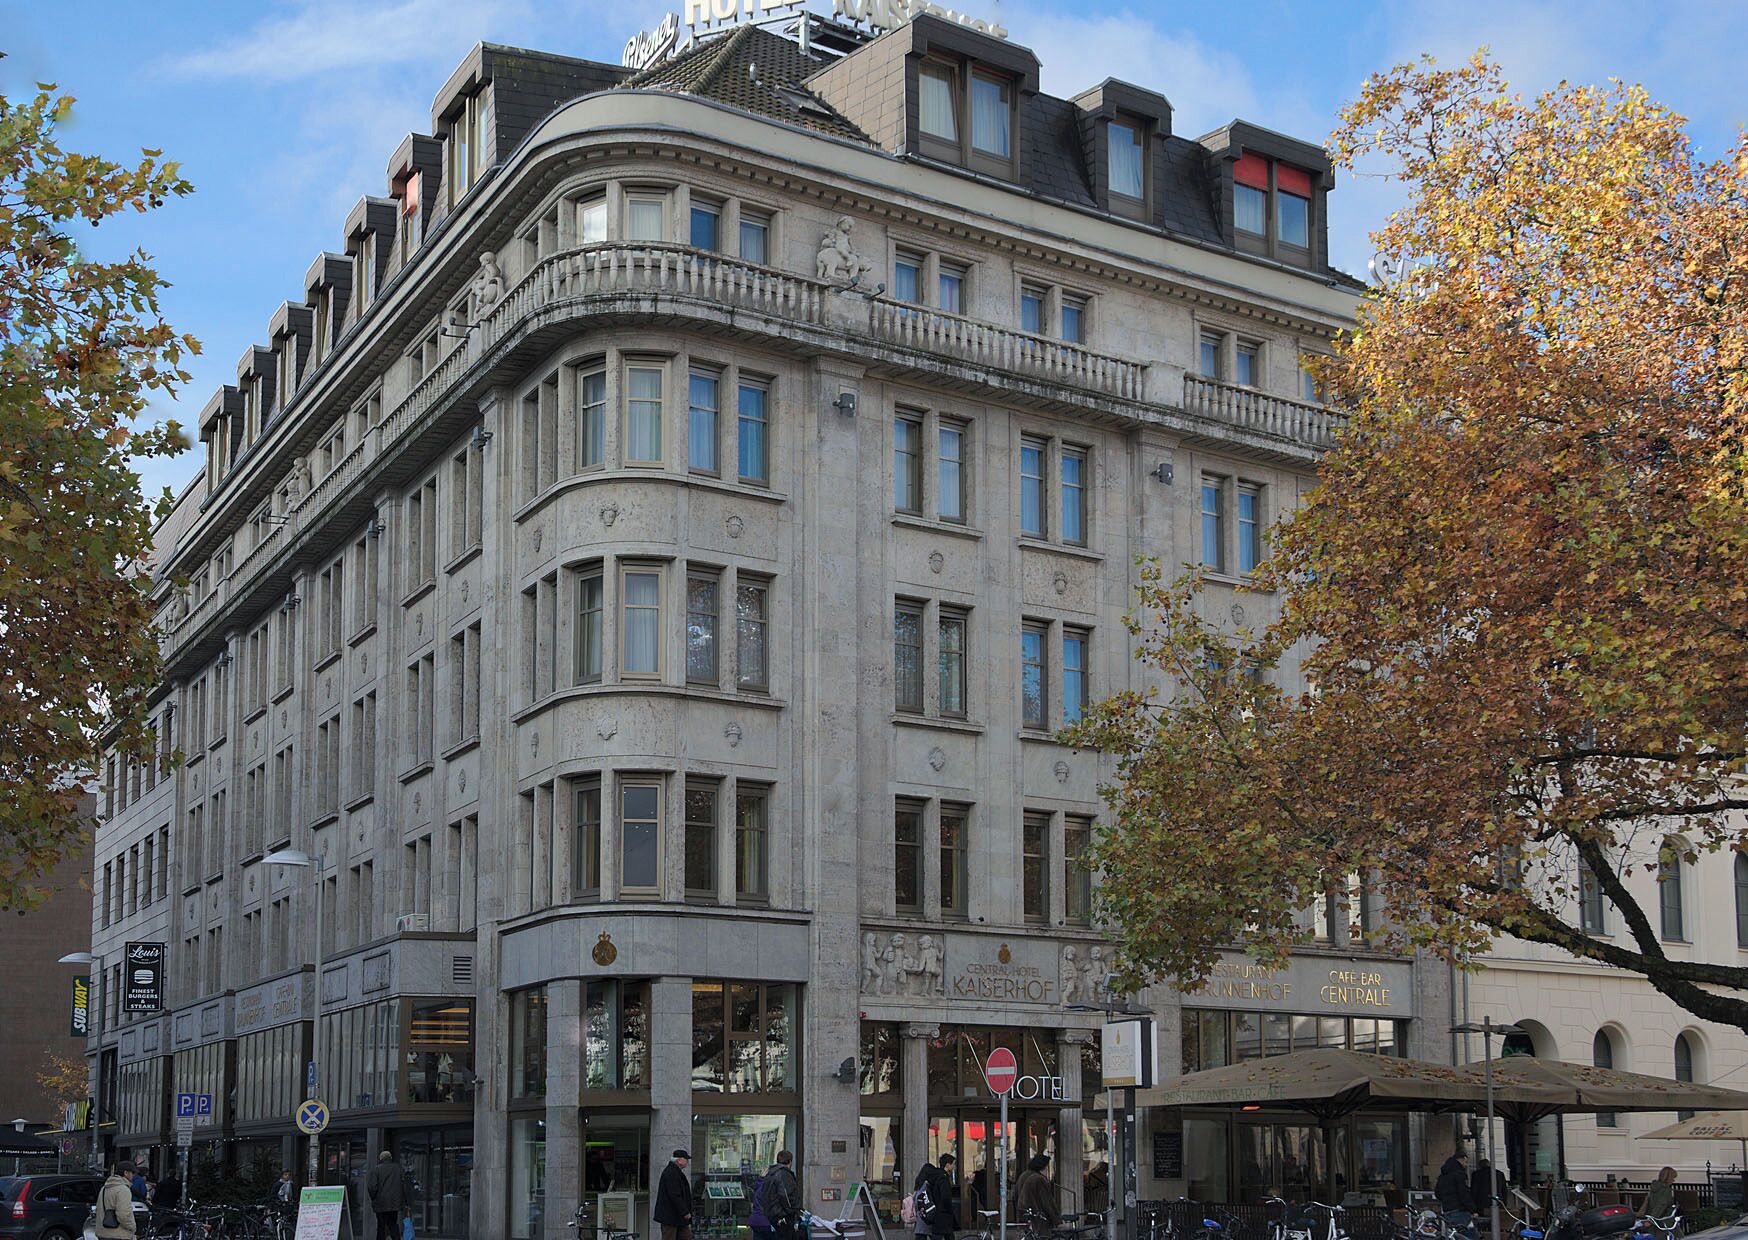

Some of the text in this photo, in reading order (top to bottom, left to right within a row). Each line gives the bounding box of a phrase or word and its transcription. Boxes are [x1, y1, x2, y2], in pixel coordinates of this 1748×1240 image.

[128, 945, 161, 959] Louis
[967, 963, 1041, 978] CENTRAL HOTEL
[1212, 963, 1278, 981] ESTAURAN
[953, 976, 1054, 1001] KAISERHOF
[1320, 985, 1392, 1007] CENTRALE
[74, 979, 88, 1033] SUBWAY
[999, 1075, 1071, 1100] OTEL
[181, 1096, 192, 1115] P
[200, 1097, 208, 1113] P
